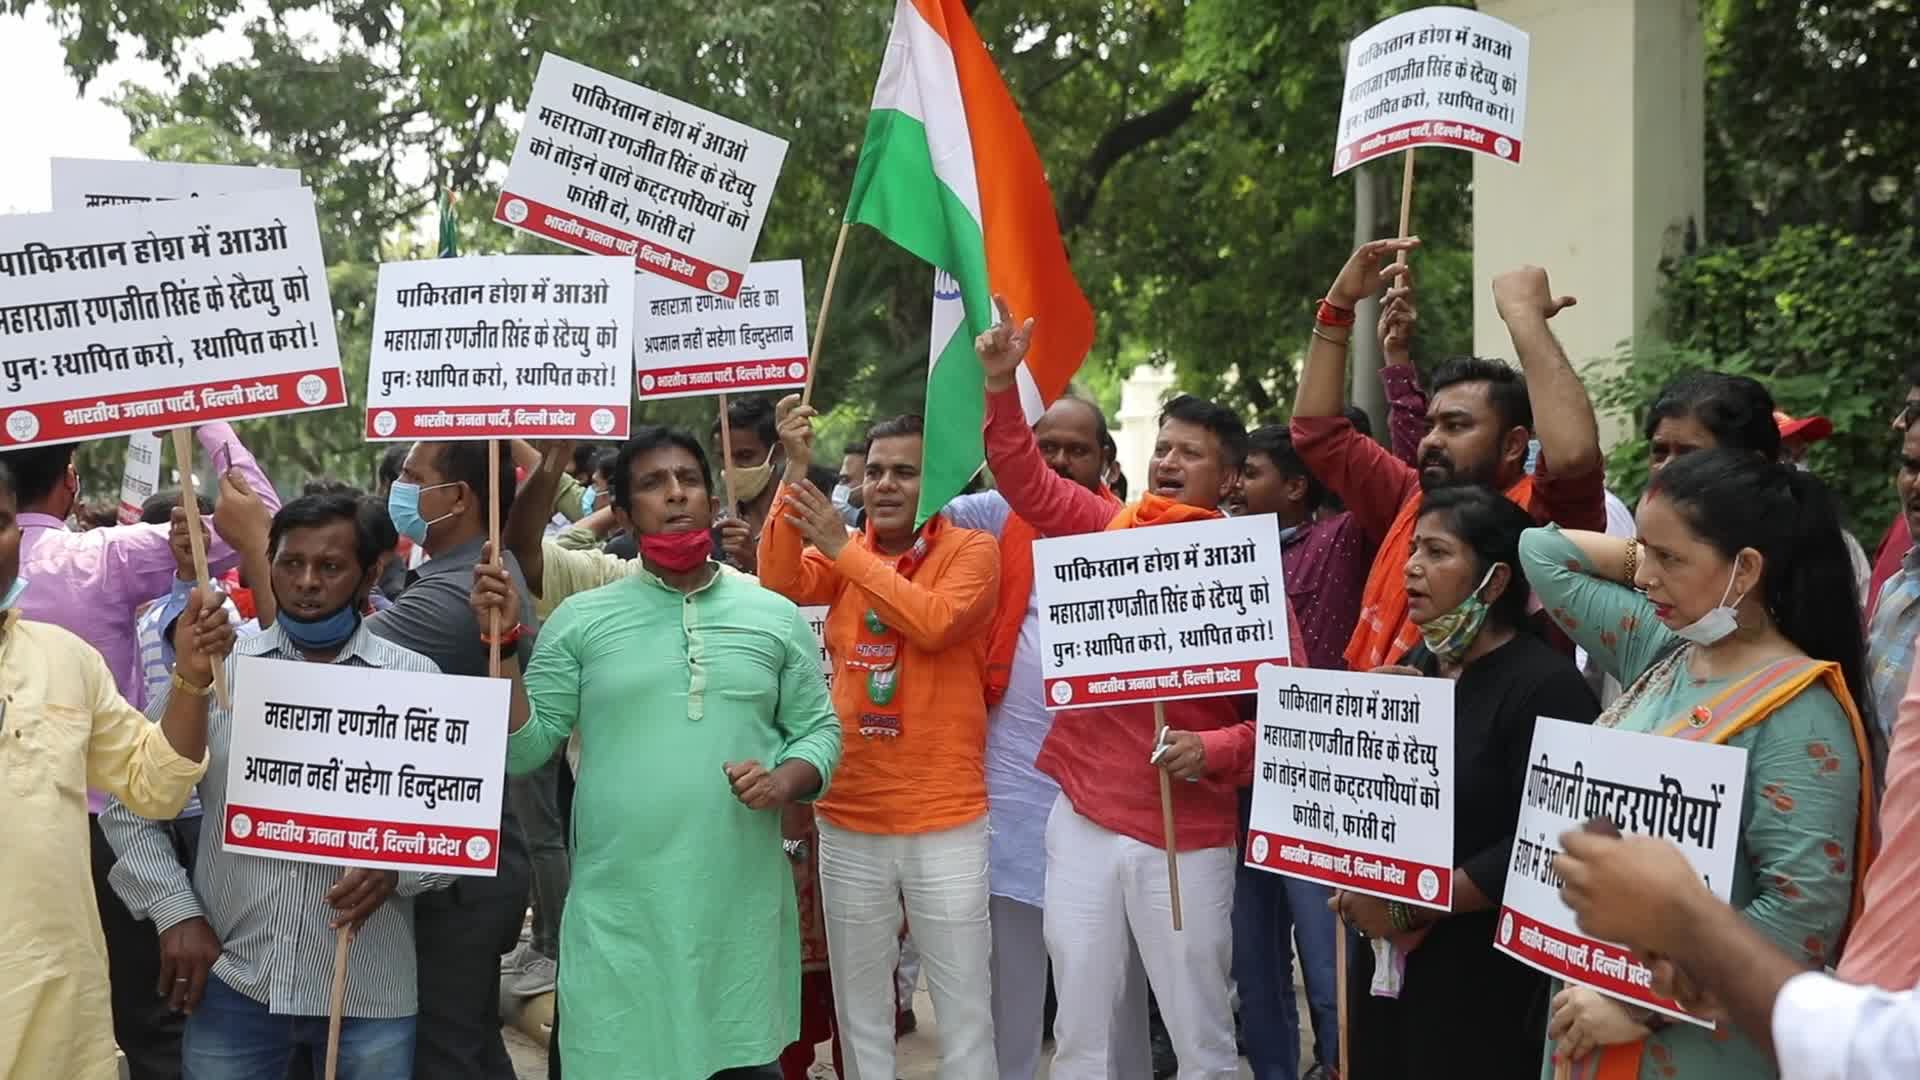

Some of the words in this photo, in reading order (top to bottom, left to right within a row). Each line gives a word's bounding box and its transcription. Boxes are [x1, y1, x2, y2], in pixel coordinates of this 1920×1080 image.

[572, 83, 653, 127] पाकिस्तान
[652, 111, 688, 140] होश
[687, 122, 706, 145] में
[702, 132, 750, 163] आओ
[539, 106, 608, 150] महाराजा
[608, 131, 669, 167] रणजीत
[667, 148, 701, 179] सिंह
[700, 163, 719, 185] के
[719, 168, 758, 208] स्टैच्यु
[529, 137, 555, 161] को
[554, 144, 599, 177] तोड़ने
[599, 162, 635, 189] वाले
[726, 209, 751, 232] को
[567, 184, 610, 214] फांसी
[636, 208, 678, 238] फांसी
[677, 222, 697, 245] दो
[0, 242, 128, 278] पाकिस्तान
[131, 231, 185, 265] होश
[188, 224, 212, 258] में
[217, 218, 288, 256] आओ
[544, 212, 584, 238] भारतीय
[584, 228, 615, 249] जनता
[639, 241, 670, 269] दिल्ली
[671, 258, 696, 278] प्रदेश
[81, 285, 161, 326] रणजीत
[160, 278, 202, 318] सिंह
[203, 275, 225, 313] के
[227, 272, 281, 318] स्टैच्यु
[281, 266, 311, 304] को
[397, 282, 486, 309] पाकिस्तान
[489, 278, 529, 305] होश
[531, 277, 551, 304] में
[553, 278, 610, 305] आओ
[649, 297, 693, 317] महाराजा
[739, 285, 761, 309] सिंह
[763, 289, 780, 307] का
[51, 343, 130, 378] स्थापित
[132, 335, 185, 369] करो,
[191, 328, 265, 361] स्थापित
[267, 320, 319, 352] करो!
[384, 328, 444, 353] महाराजा
[445, 320, 501, 350] रणजीत
[502, 318, 532, 349] सिंह
[534, 318, 550, 349] के
[553, 318, 592, 358] स्टैच्यु
[596, 319, 619, 349] को
[644, 334, 681, 354] अपमान
[681, 327, 705, 350] नहीं
[705, 325, 737, 349] सहेगा
[739, 323, 794, 351] हिन्दुस्तान
[416, 363, 470, 389] स्थापित
[516, 362, 574, 387] स्थापित
[657, 372, 687, 388] भारतीय
[689, 371, 711, 384] जनता
[736, 366, 761, 382] दिल्ली
[762, 366, 786, 381] प्रदेश
[63, 401, 120, 425] भारतीय
[122, 400, 164, 418] जनता
[167, 392, 201, 412] पार्टी,
[203, 388, 244, 409] दिल्ली
[246, 382, 278, 402] प्रदेश
[414, 411, 454, 428] भारतीय
[457, 412, 486, 427] जनता
[515, 408, 547, 426] दिल्ली
[549, 409, 576, 427] प्रदेश
[1053, 556, 1140, 583] पाकिस्तान
[1143, 547, 1181, 574] होश
[1183, 543, 1201, 569] में
[1204, 537, 1257, 568] आओ
[1048, 599, 1105, 625] महाराजा
[1106, 589, 1159, 620] रणजीत
[1160, 584, 1189, 615] सिंह
[1190, 582, 1206, 611] के
[1208, 580, 1248, 617] स्टैच्यु
[1248, 576, 1270, 606] को
[1084, 632, 1136, 658] स्थापित
[1137, 627, 1173, 654] करो,
[1179, 623, 1233, 649] स्थापित
[1235, 618, 1274, 644] करो!
[1088, 677, 1126, 694] भारतीय
[1128, 678, 1155, 690] जनता
[1158, 671, 1182, 689] पार्टी,
[1184, 669, 1215, 685] दिल्ली
[1217, 667, 1241, 684] प्रदेश
[264, 701, 334, 734] महाराजा
[337, 704, 400, 740] रणजीत
[404, 707, 441, 744] सिंह
[445, 718, 470, 746] का
[1279, 684, 1334, 715] पाकिस्तान
[1335, 688, 1365, 719] होश
[1366, 690, 1380, 720] में
[1381, 694, 1422, 725] आओ
[1264, 724, 1308, 751] महाराजा
[1308, 727, 1356, 758] रणजीत
[1357, 730, 1385, 761] सिंह
[1386, 733, 1401, 763] के
[1403, 735, 1440, 778] स्टैच्यु
[244, 756, 305, 788] अपमान
[306, 757, 344, 792] नहीं
[344, 760, 394, 797] सहेगा
[398, 764, 485, 810] हिन्दुस्तान
[1263, 756, 1278, 784] को
[1279, 759, 1307, 793] तोड़ने
[1309, 765, 1332, 793] वाले
[1420, 780, 1441, 811] को
[257, 820, 304, 843] भारतीय
[306, 829, 345, 848] जनता
[348, 829, 380, 854] पार्टी,
[383, 830, 426, 854] दिल्ली
[428, 835, 460, 856] प्रदेश
[1293, 800, 1322, 830] फांसी
[1323, 805, 1339, 838] दो,
[1342, 809, 1380, 841] फांसी
[1381, 815, 1397, 844] दो
[1332, 854, 1353, 877] पार्टी,
[1354, 858, 1382, 880] दिल्ली
[1383, 863, 1405, 885] प्रदेश
